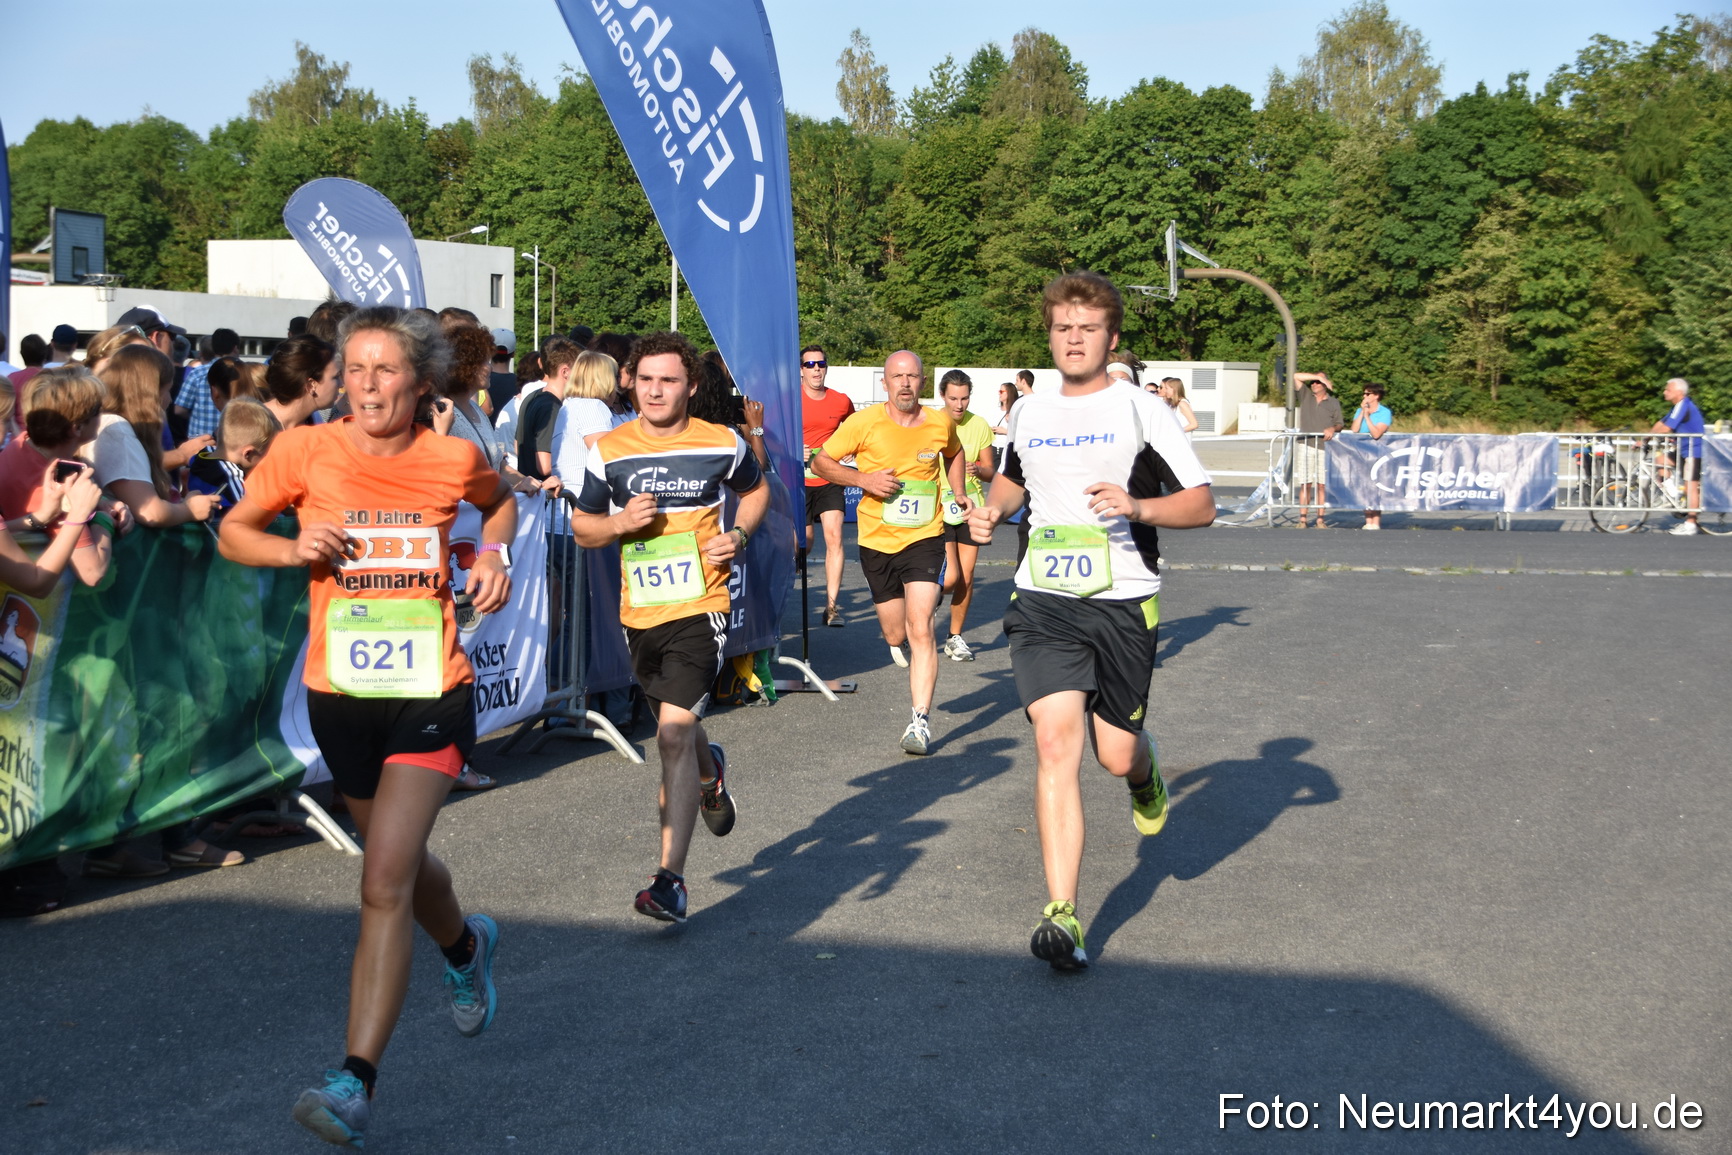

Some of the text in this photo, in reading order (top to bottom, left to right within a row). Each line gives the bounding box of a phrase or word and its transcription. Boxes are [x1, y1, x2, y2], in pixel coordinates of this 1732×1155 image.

[1028, 433, 1115, 448] DELPHI
[641, 477, 707, 492] Fischer
[1395, 466, 1510, 488] Fischer
[1405, 489, 1499, 500] AUTOMOBILE
[899, 499, 919, 515] 51
[344, 510, 422, 525] 30 Jahre
[1044, 555, 1092, 577] 270
[633, 561, 692, 588] 1517
[349, 638, 414, 670] 621
[350, 676, 418, 684] Sylvana Kuhlemann
